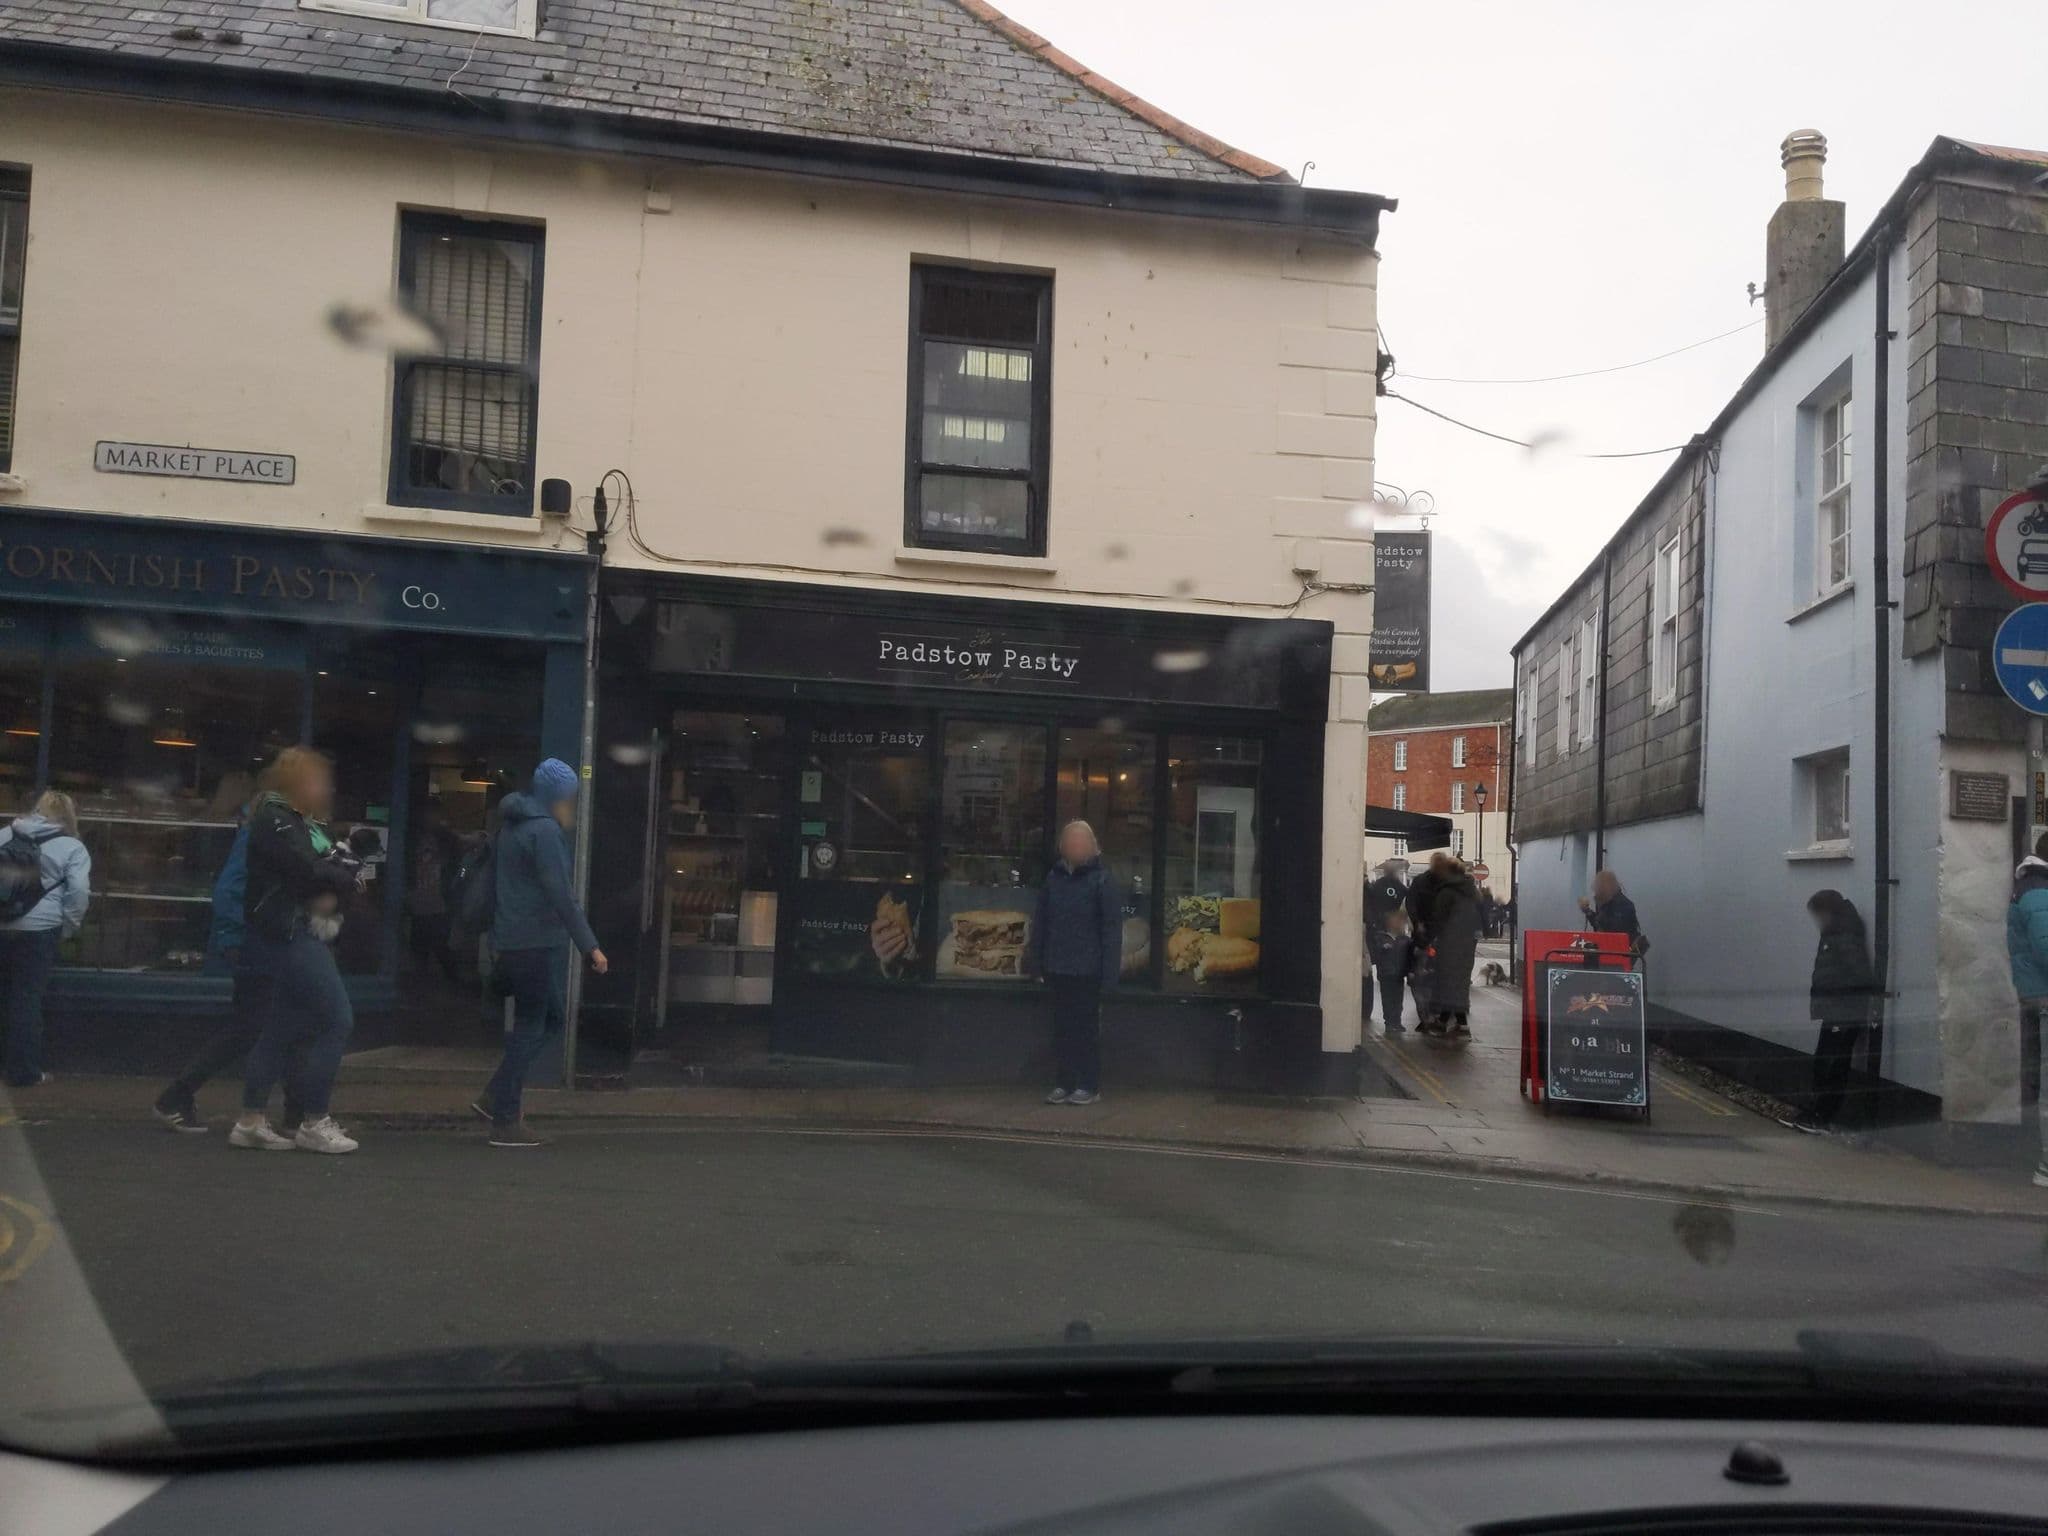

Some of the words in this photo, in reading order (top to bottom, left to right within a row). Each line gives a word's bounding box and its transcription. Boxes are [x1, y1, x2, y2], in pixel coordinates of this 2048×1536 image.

[106, 448, 207, 473] MARKET
[215, 455, 286, 480] PLACE
[1376, 545, 1423, 556] adstow
[1376, 557, 1413, 569] Pasty
[0, 541, 206, 591] ORNISH
[233, 555, 376, 605] PASTY
[401, 585, 447, 611] Co.
[879, 640, 992, 666] Padstow
[1003, 649, 1079, 678] Pasty
[811, 730, 874, 744] Padstow
[880, 731, 925, 747] Pasty
[800, 919, 839, 929] Padstow
[843, 920, 869, 933] Pasty
[1580, 1068, 1607, 1078] Market
[1608, 1070, 1634, 1080] Strand
